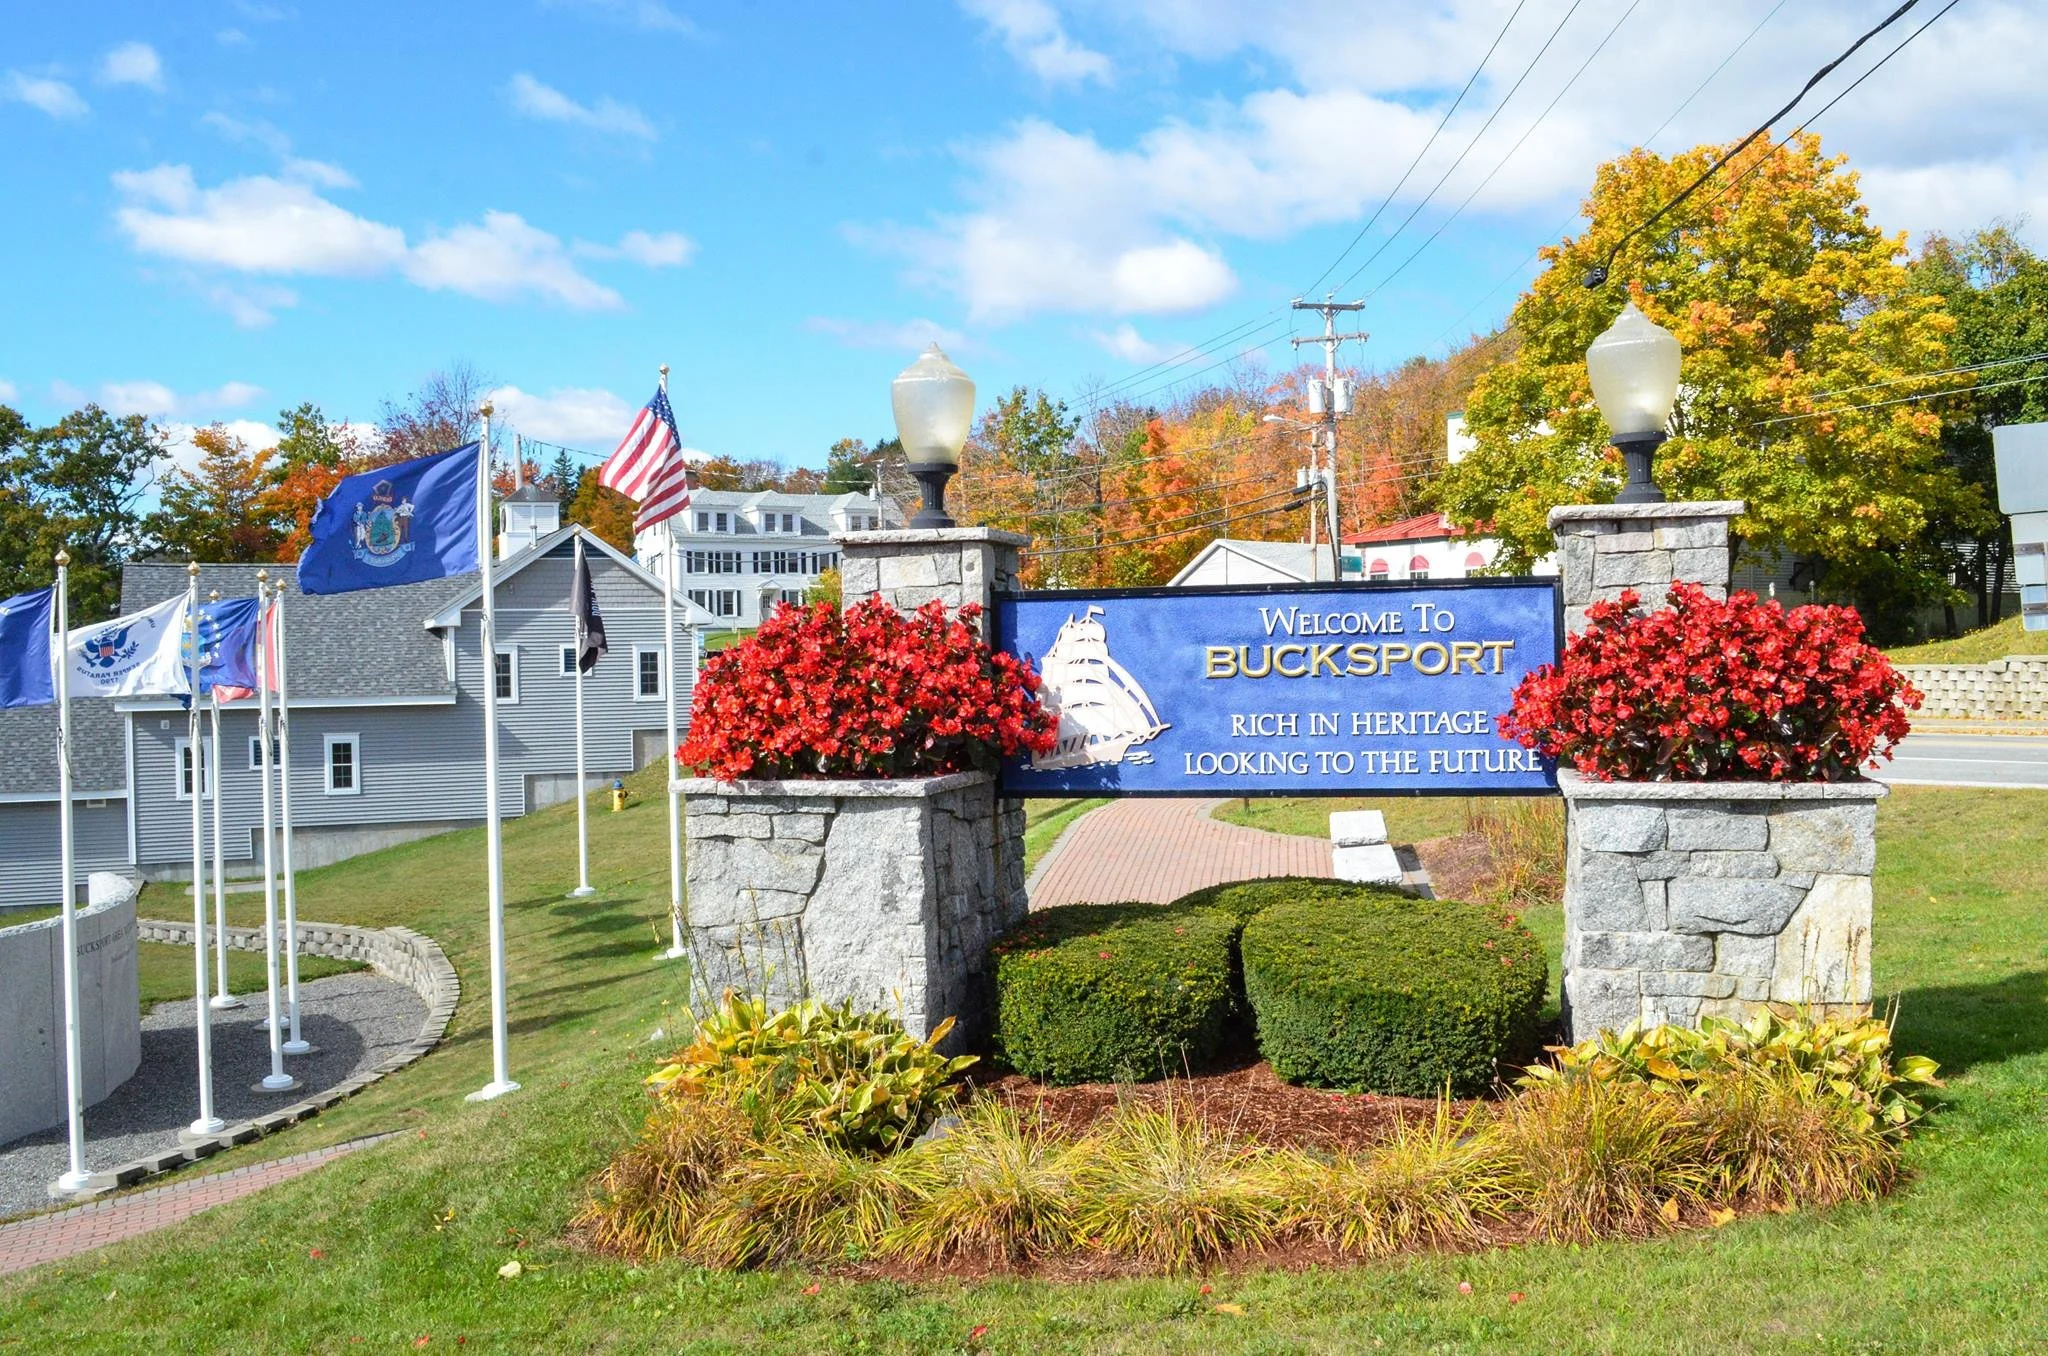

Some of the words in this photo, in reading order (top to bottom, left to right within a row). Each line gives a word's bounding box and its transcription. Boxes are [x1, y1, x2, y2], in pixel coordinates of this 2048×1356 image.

[1205, 640, 1515, 679] BUCKSPORT
[1230, 712, 1300, 738] RICH
[1308, 712, 1341, 736] IN
[1351, 710, 1490, 736] HERITAGE
[1184, 751, 1310, 776] LOOKING
[1315, 751, 1356, 775] TO
[1361, 750, 1421, 774] THE
[1429, 747, 1544, 774] FUTURE
